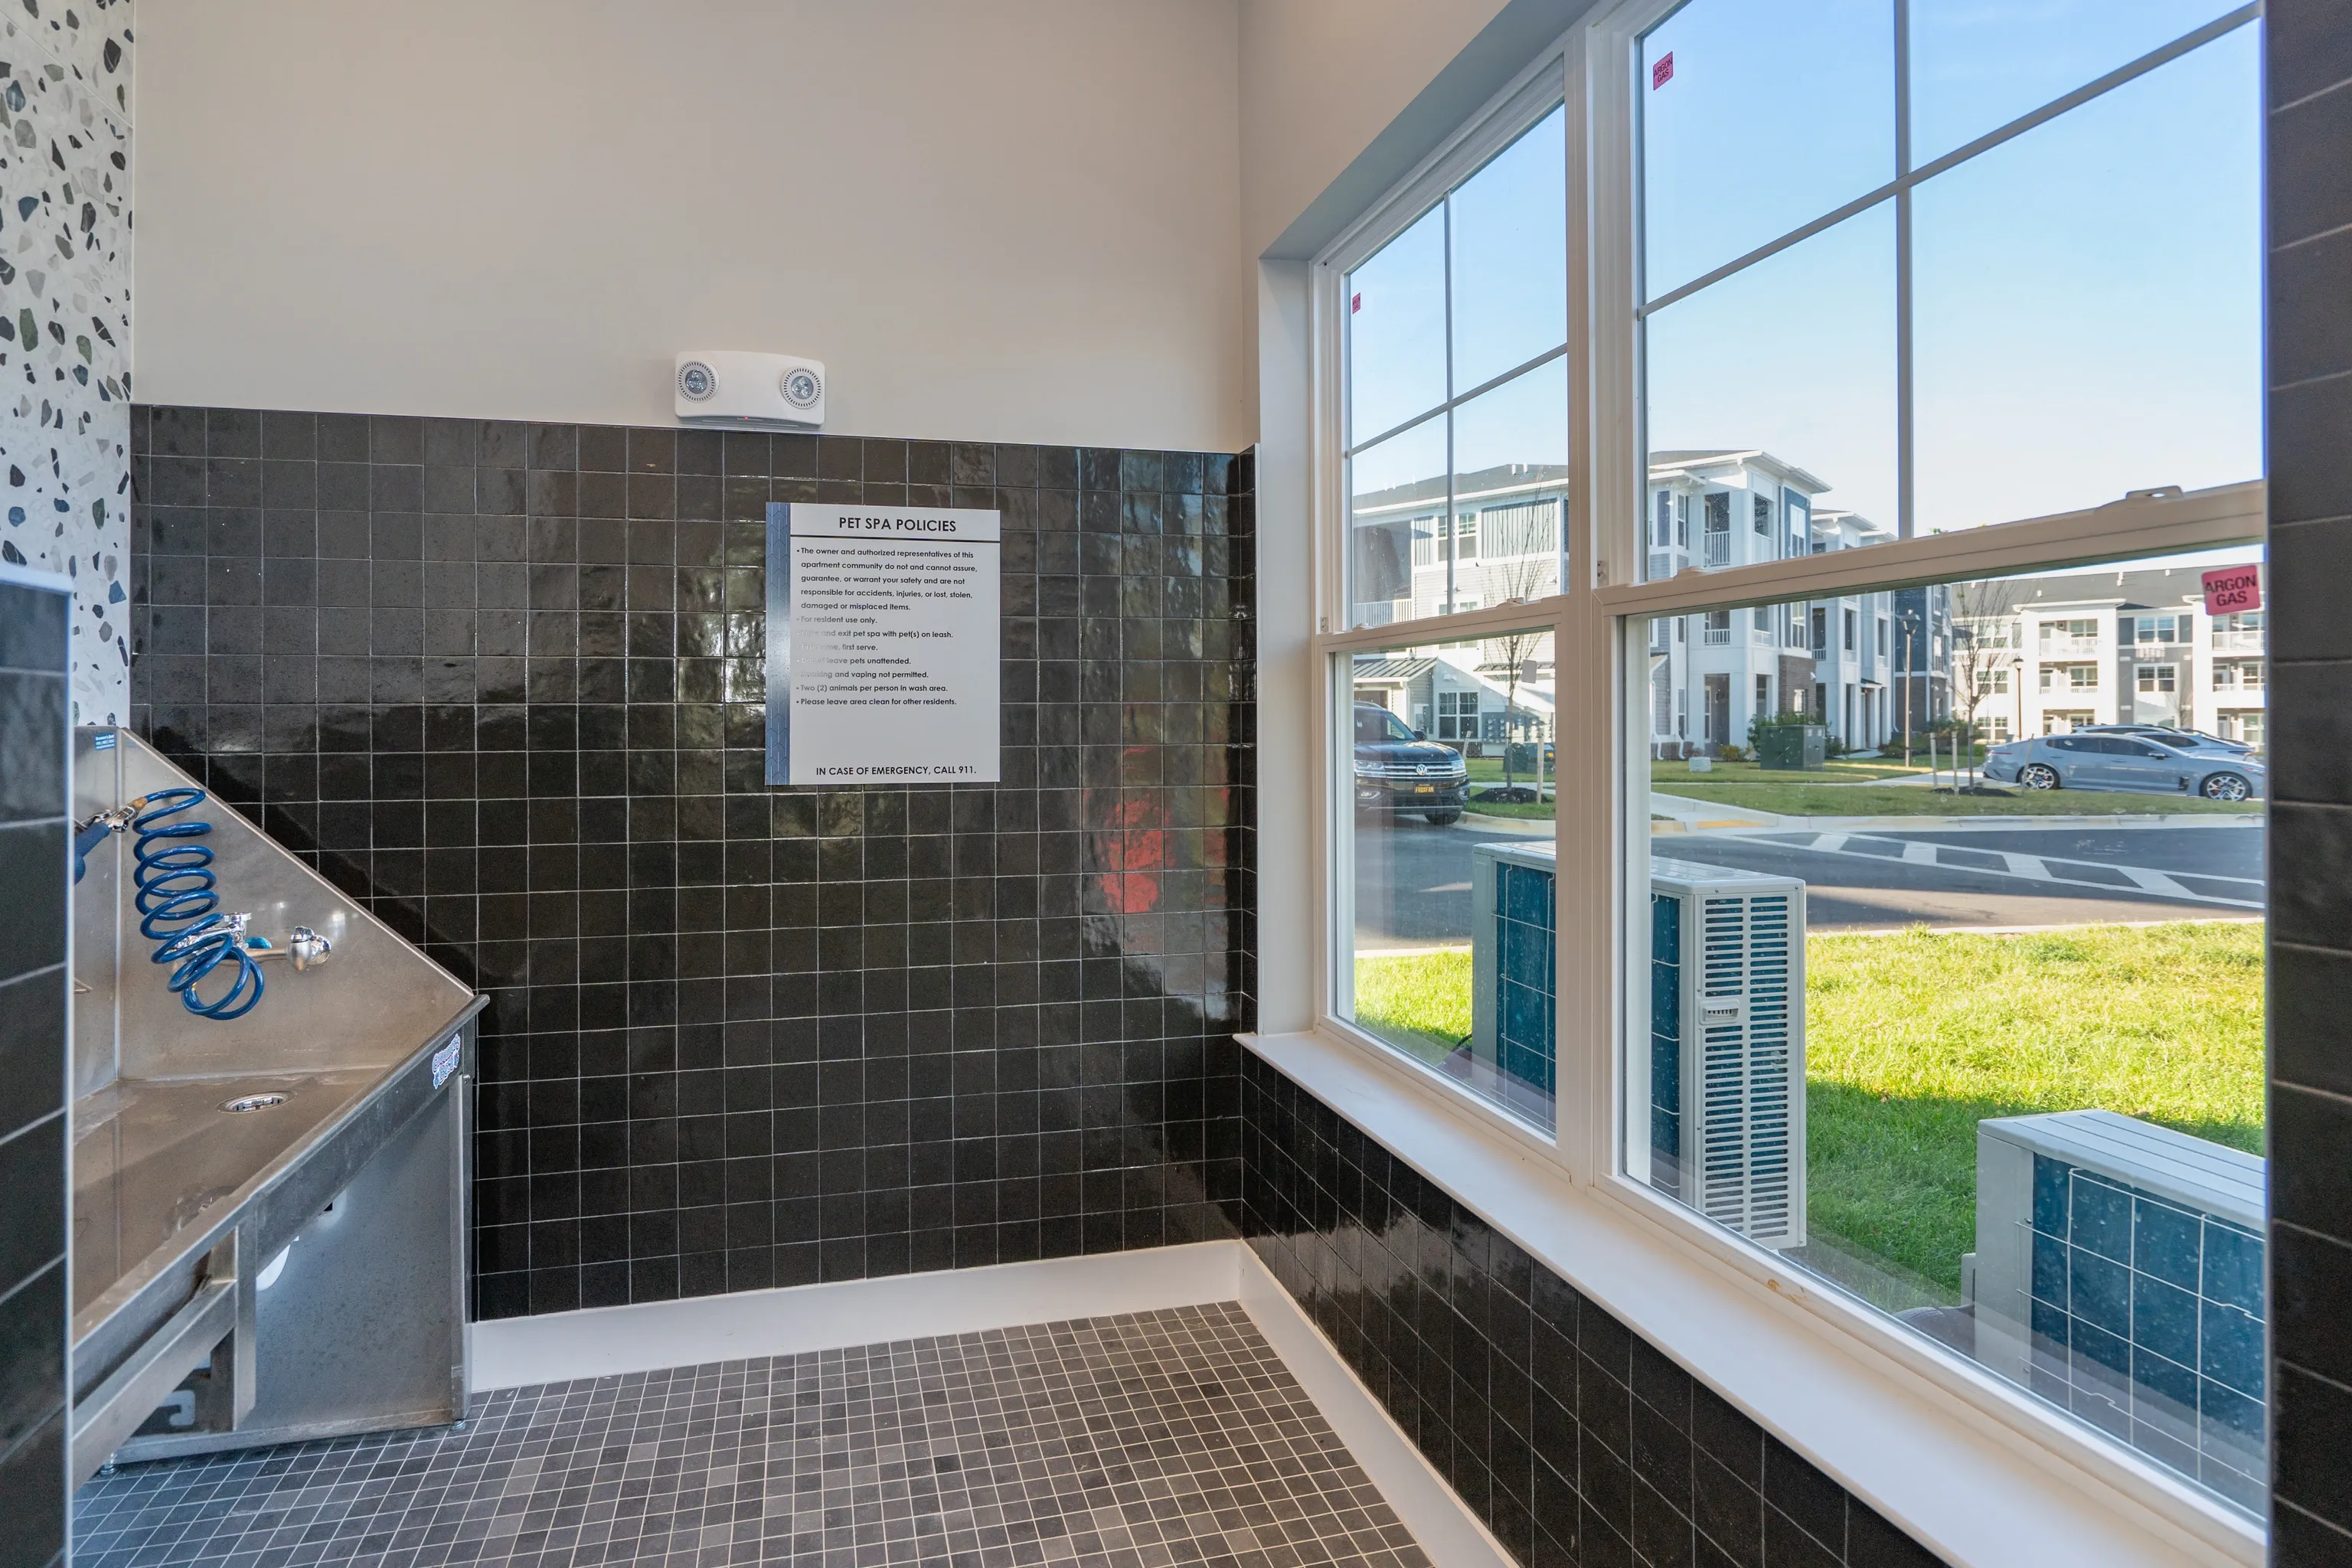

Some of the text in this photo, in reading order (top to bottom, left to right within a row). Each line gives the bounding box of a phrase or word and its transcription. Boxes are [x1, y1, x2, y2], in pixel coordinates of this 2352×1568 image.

[1654, 57, 1673, 78] ARGON
[1657, 69, 1669, 83] GAS
[840, 518, 956, 532] PET SPA POLICIES
[900, 577, 922, 586] safety
[2204, 575, 2256, 593] ARGON
[896, 590, 923, 599] injuries,
[2216, 591, 2247, 606] GAS
[801, 603, 838, 611] damaged
[898, 631, 919, 639] pet(s)
[816, 684, 827, 693] (2)
[829, 767, 854, 776] CASE
[857, 767, 869, 776] OF
[872, 766, 931, 776] EMERGENCY,
